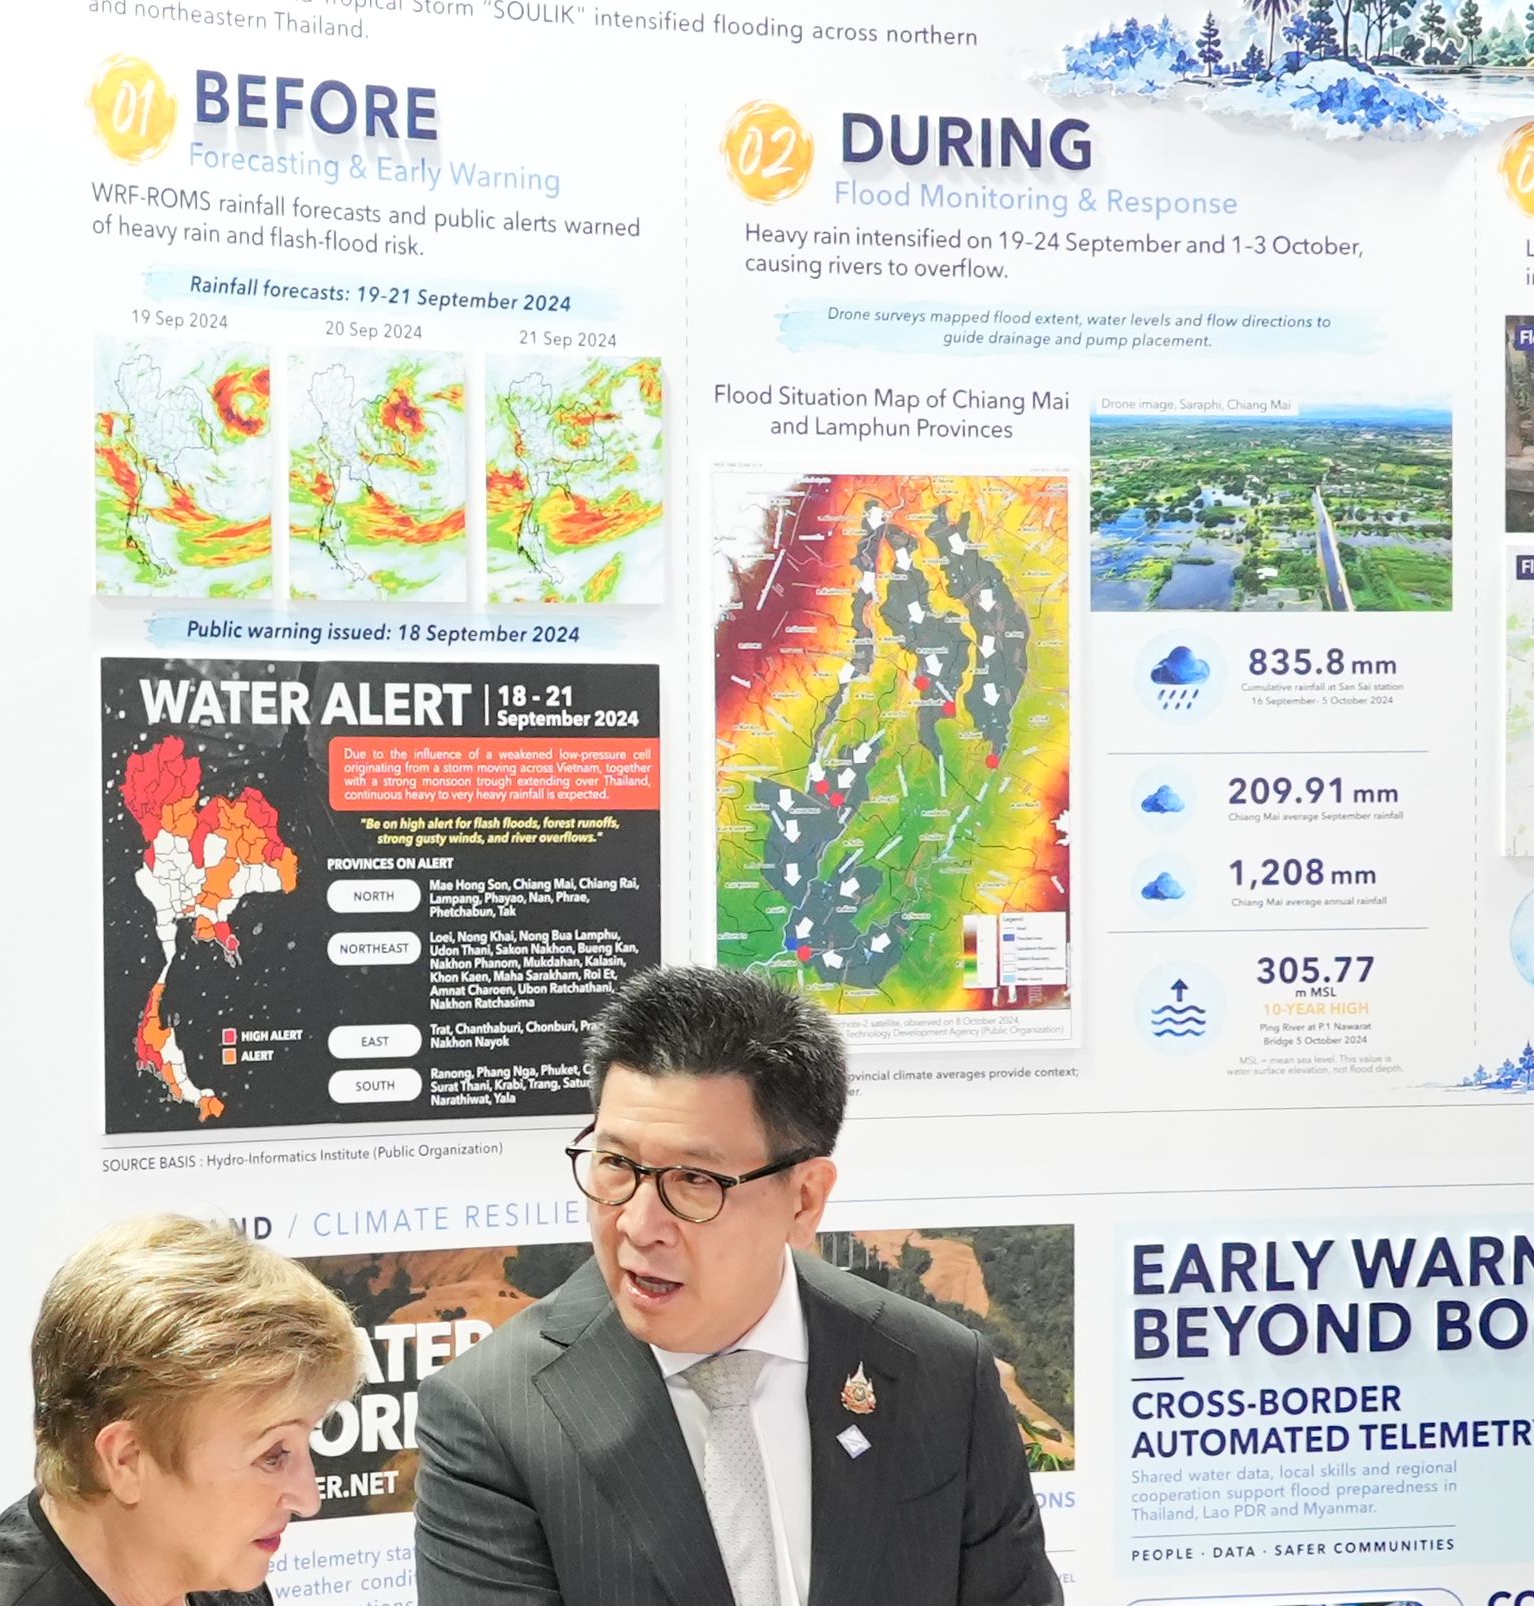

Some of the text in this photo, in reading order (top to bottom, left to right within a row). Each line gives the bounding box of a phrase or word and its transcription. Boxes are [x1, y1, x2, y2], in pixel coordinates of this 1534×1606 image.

[111, 78, 157, 138] 01
[195, 69, 438, 141] BEFORE
[737, 125, 798, 179] 02
[842, 112, 1092, 171] DURING
[190, 140, 561, 200] Forecasting & Early Warning
[835, 178, 1238, 221] Flood Monitoring & Response
[92, 212, 424, 256] of heavy rain and flash-flood risk.
[190, 274, 572, 313] Rainfall forecasts: 19-21 September 2024
[131, 308, 229, 331] 19 Sep 2024
[714, 383, 1070, 416] Flood Situation Map of Chiang Mai
[770, 414, 1014, 443] and Lamphun Provinces
[186, 619, 580, 647] Public warning issued: 18 September 2024
[1248, 647, 1397, 676] 835.8 mm
[139, 678, 473, 729] WATER ALERT
[497, 684, 527, 707] 18
[545, 684, 572, 707] 21
[496, 708, 640, 732] September 2024
[1228, 776, 1399, 805] 209.91 mm
[326, 856, 455, 871] PROVINCES ON ALERT
[1229, 857, 1377, 891] 1,208 mm
[353, 890, 395, 902] NORTH
[339, 942, 410, 955] NORTHEAST
[1256, 955, 1375, 985] 305.77
[1295, 986, 1338, 998] m MSL
[1263, 1000, 1370, 1017] 10-YEAR HIGH
[241, 1029, 304, 1043] HIGH ALERT
[360, 1035, 390, 1048] EAST
[241, 1049, 275, 1063] ALERT
[355, 1079, 396, 1092] SOUTH
[313, 1206, 449, 1238] CLIMATE
[1133, 1239, 1336, 1296] EARLY
[1133, 1301, 1412, 1360] BEYOND
[1132, 1384, 1402, 1421] CROSS-BORDER
[1131, 1424, 1350, 1459] AUTOMATED
[1131, 1538, 1455, 1562] PEOPLE DATA SAFER COMMUNITIES
